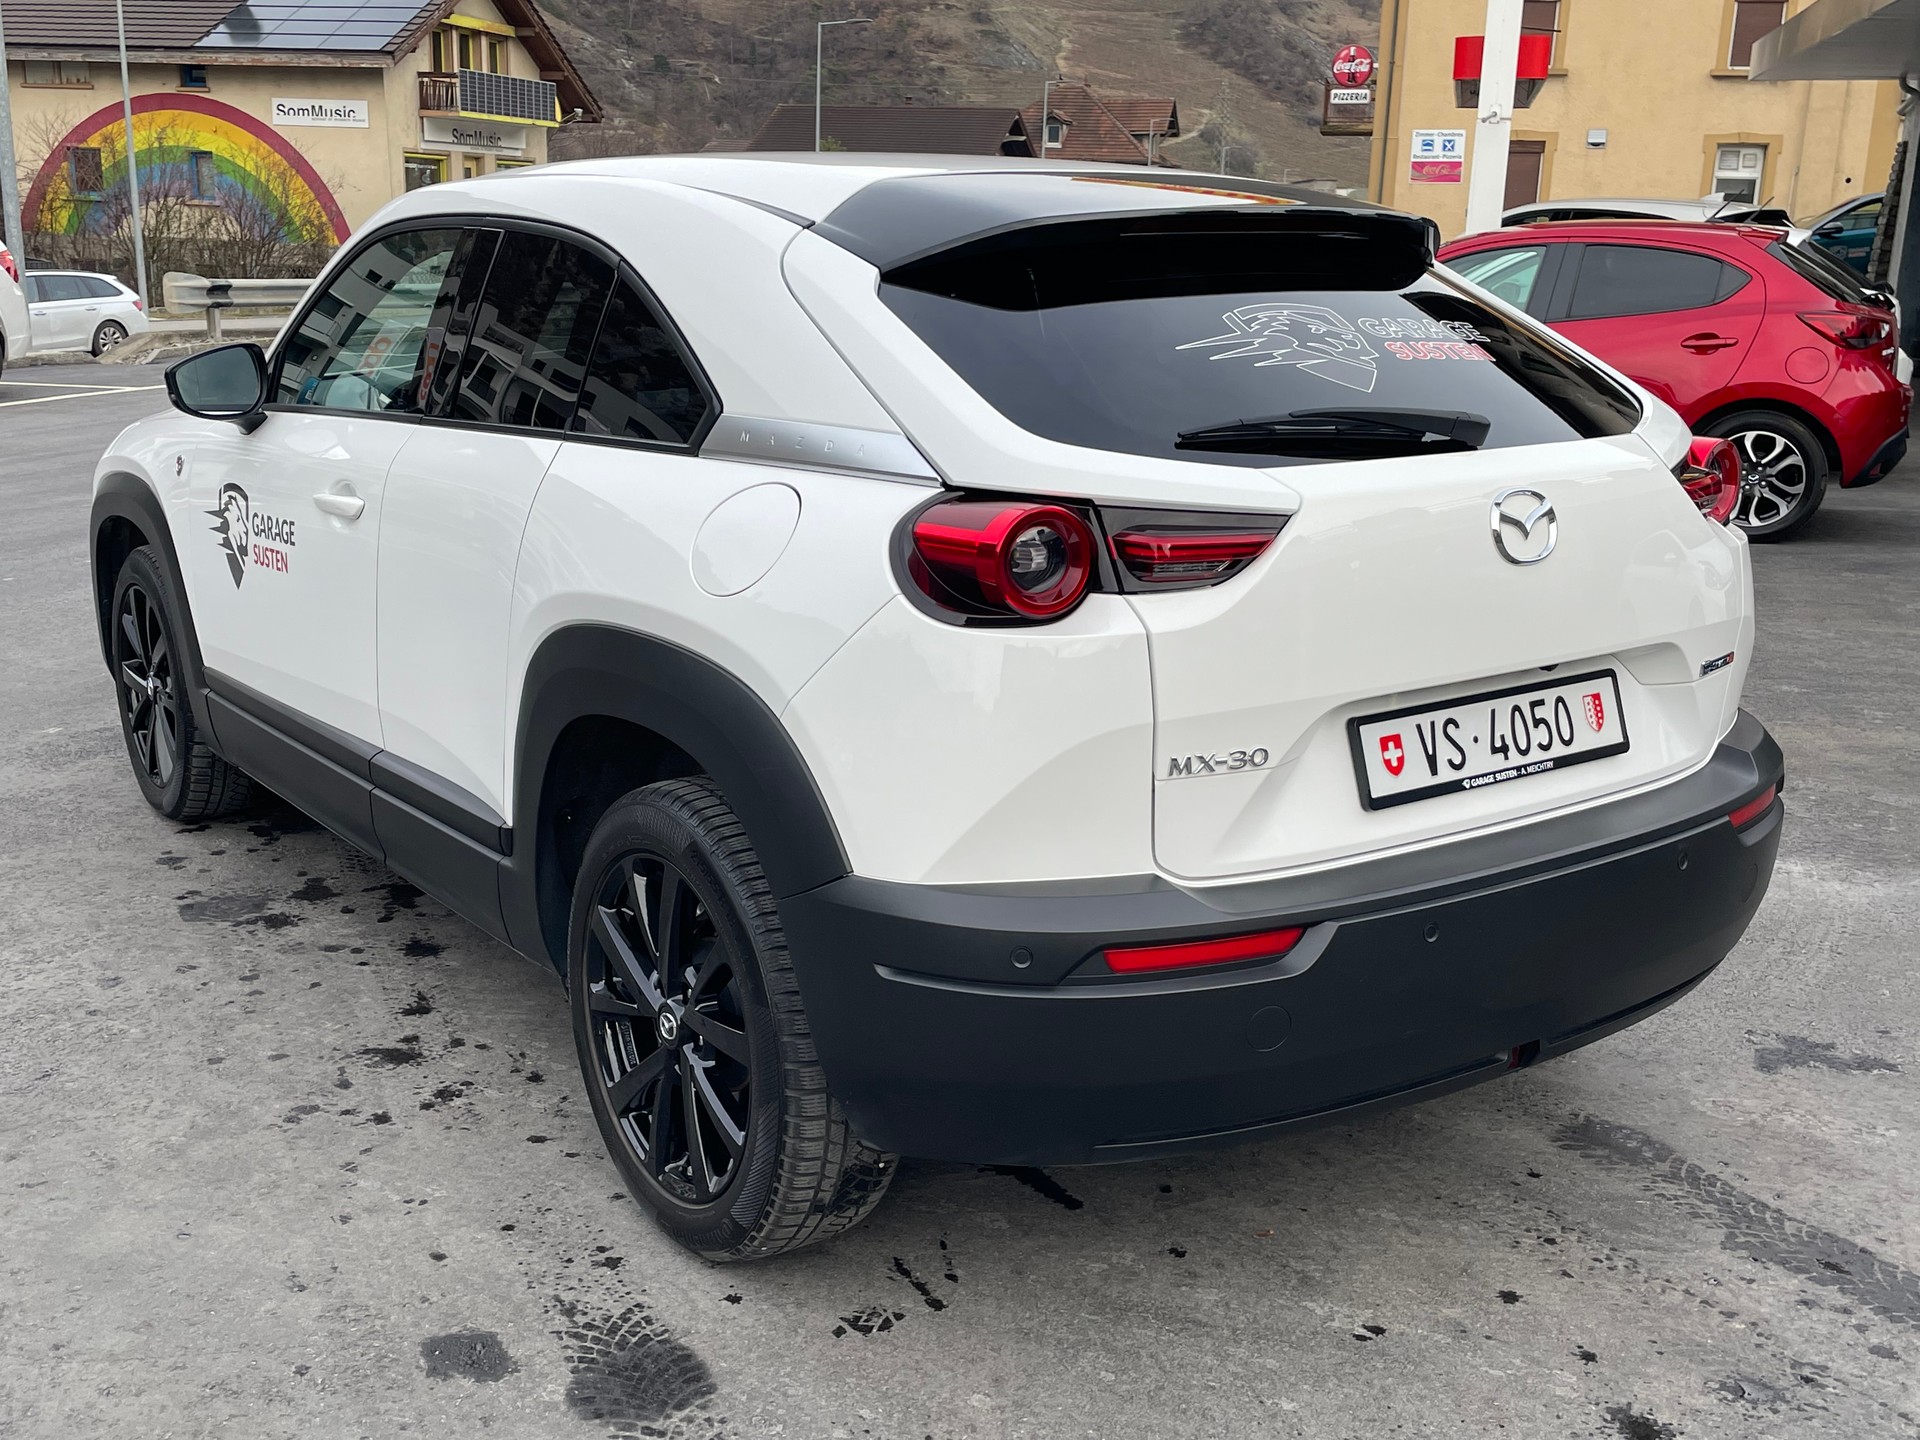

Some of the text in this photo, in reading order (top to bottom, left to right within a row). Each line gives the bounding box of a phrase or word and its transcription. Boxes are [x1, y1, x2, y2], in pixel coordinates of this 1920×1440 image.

[1332, 92, 1368, 101] PIZZERIA
[276, 103, 357, 118] SomMusic
[452, 128, 502, 147] SomMusic
[1357, 317, 1491, 342] GARAGE
[1384, 341, 1496, 361] SUSTEN
[252, 512, 296, 546] GARAGE
[253, 543, 289, 573] SUSTEN
[1168, 747, 1269, 777] MX-30
[1471, 775, 1494, 786] GARAGE
[1496, 769, 1517, 781] SUSTEN
[1527, 761, 1554, 774] MEICHTRY
